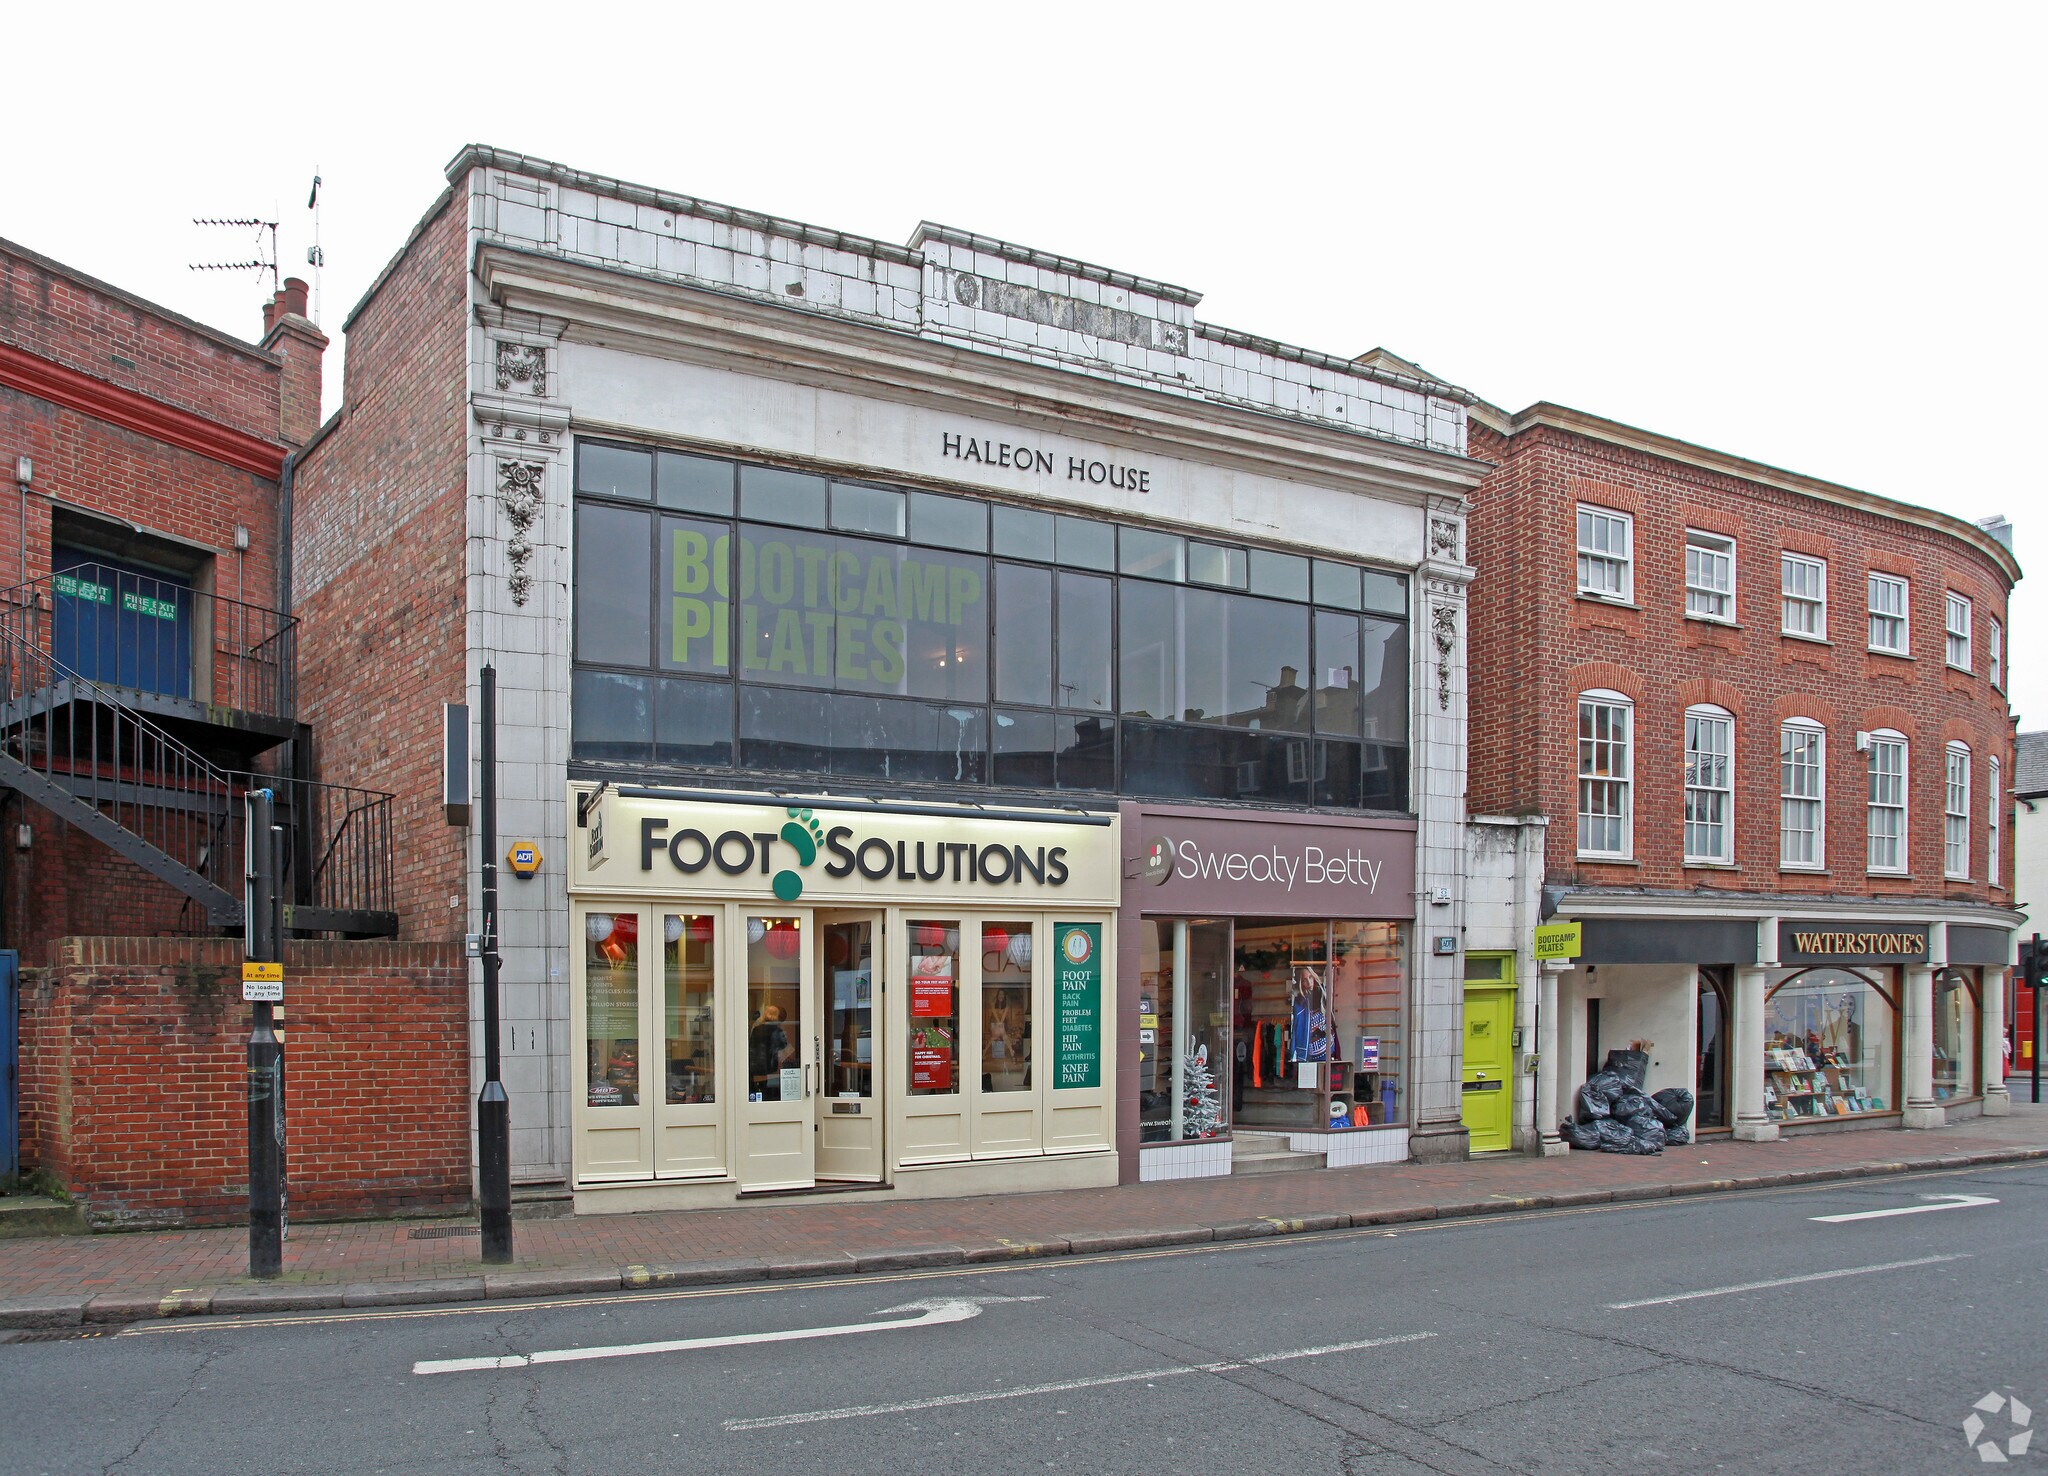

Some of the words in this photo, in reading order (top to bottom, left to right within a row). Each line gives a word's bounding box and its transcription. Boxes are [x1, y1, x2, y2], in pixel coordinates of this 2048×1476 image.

[943, 432, 1054, 475] HALEON
[1068, 456, 1150, 493] HOUSE
[672, 528, 981, 626] BOOTCAMP
[53, 575, 77, 588] FIRE
[82, 582, 109, 596] EXIT
[57, 584, 77, 593] KEEP
[124, 593, 149, 606] FIRE
[152, 601, 176, 613] EXIT
[126, 602, 147, 612] KEEP
[671, 597, 907, 685] PILATES
[641, 817, 778, 875] FOOT
[824, 826, 1069, 885] SOLUTIONS
[516, 852, 533, 861] ADT
[1177, 840, 1300, 892] Sweaty
[1305, 846, 1382, 895] Betty
[1537, 932, 1576, 944] BOOTCAMP
[1794, 932, 1924, 954] WATERSTONE'S
[1537, 943, 1564, 953] PILATES
[1062, 970, 1092, 981] FOOT
[1062, 981, 1086, 991] PAIN
[1062, 1034, 1078, 1043] HIP
[1062, 1043, 1082, 1052] PAIN
[1062, 1053, 1096, 1061] ARTHRITIS
[1062, 1064, 1089, 1073] KNEE
[1062, 1073, 1085, 1083] PAIN
